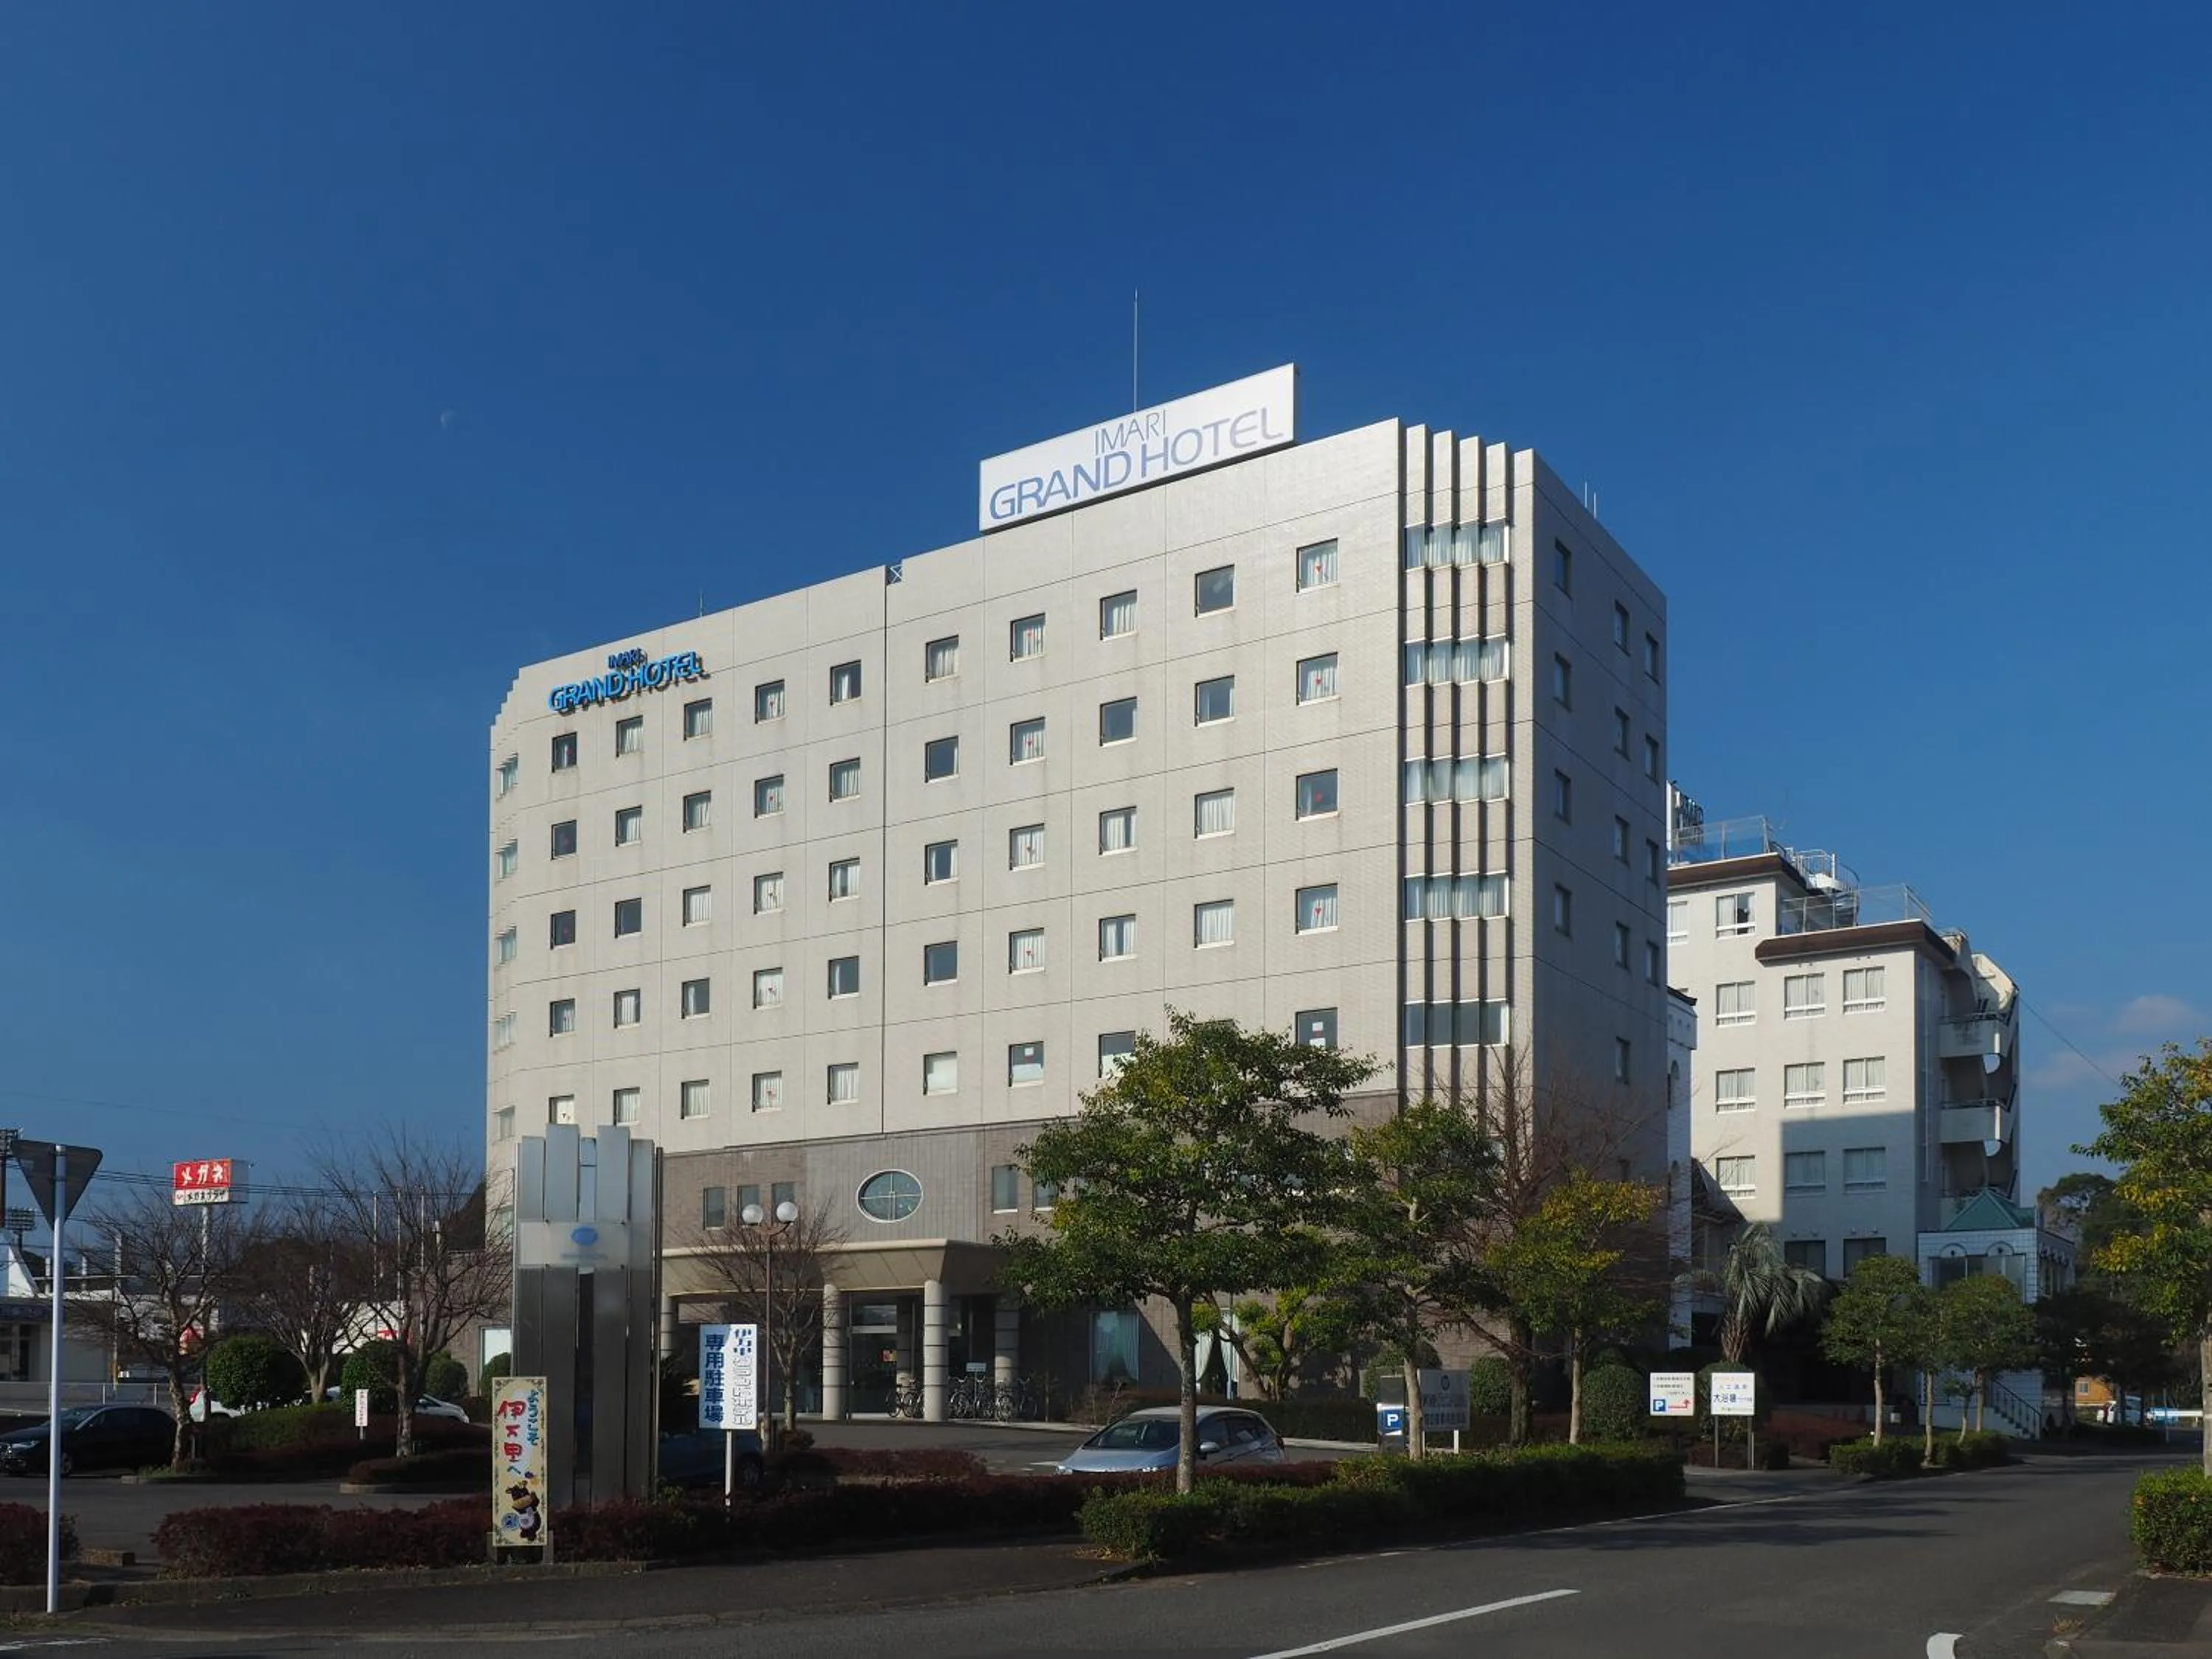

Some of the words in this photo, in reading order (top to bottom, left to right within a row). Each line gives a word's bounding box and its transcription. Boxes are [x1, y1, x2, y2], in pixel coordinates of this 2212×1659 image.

[1095, 409, 1166, 456] IMARI
[989, 451, 1132, 521] GRAND
[1141, 407, 1284, 478] HOTEL
[608, 648, 642, 669] IMARI
[548, 670, 625, 712] GRAND
[627, 651, 703, 692] HOTEL
[181, 1163, 223, 1186] メガネ
[705, 1333, 724, 1422] 専用駐車場
[1387, 1413, 1399, 1427] P
[1655, 1400, 1664, 1411] P
